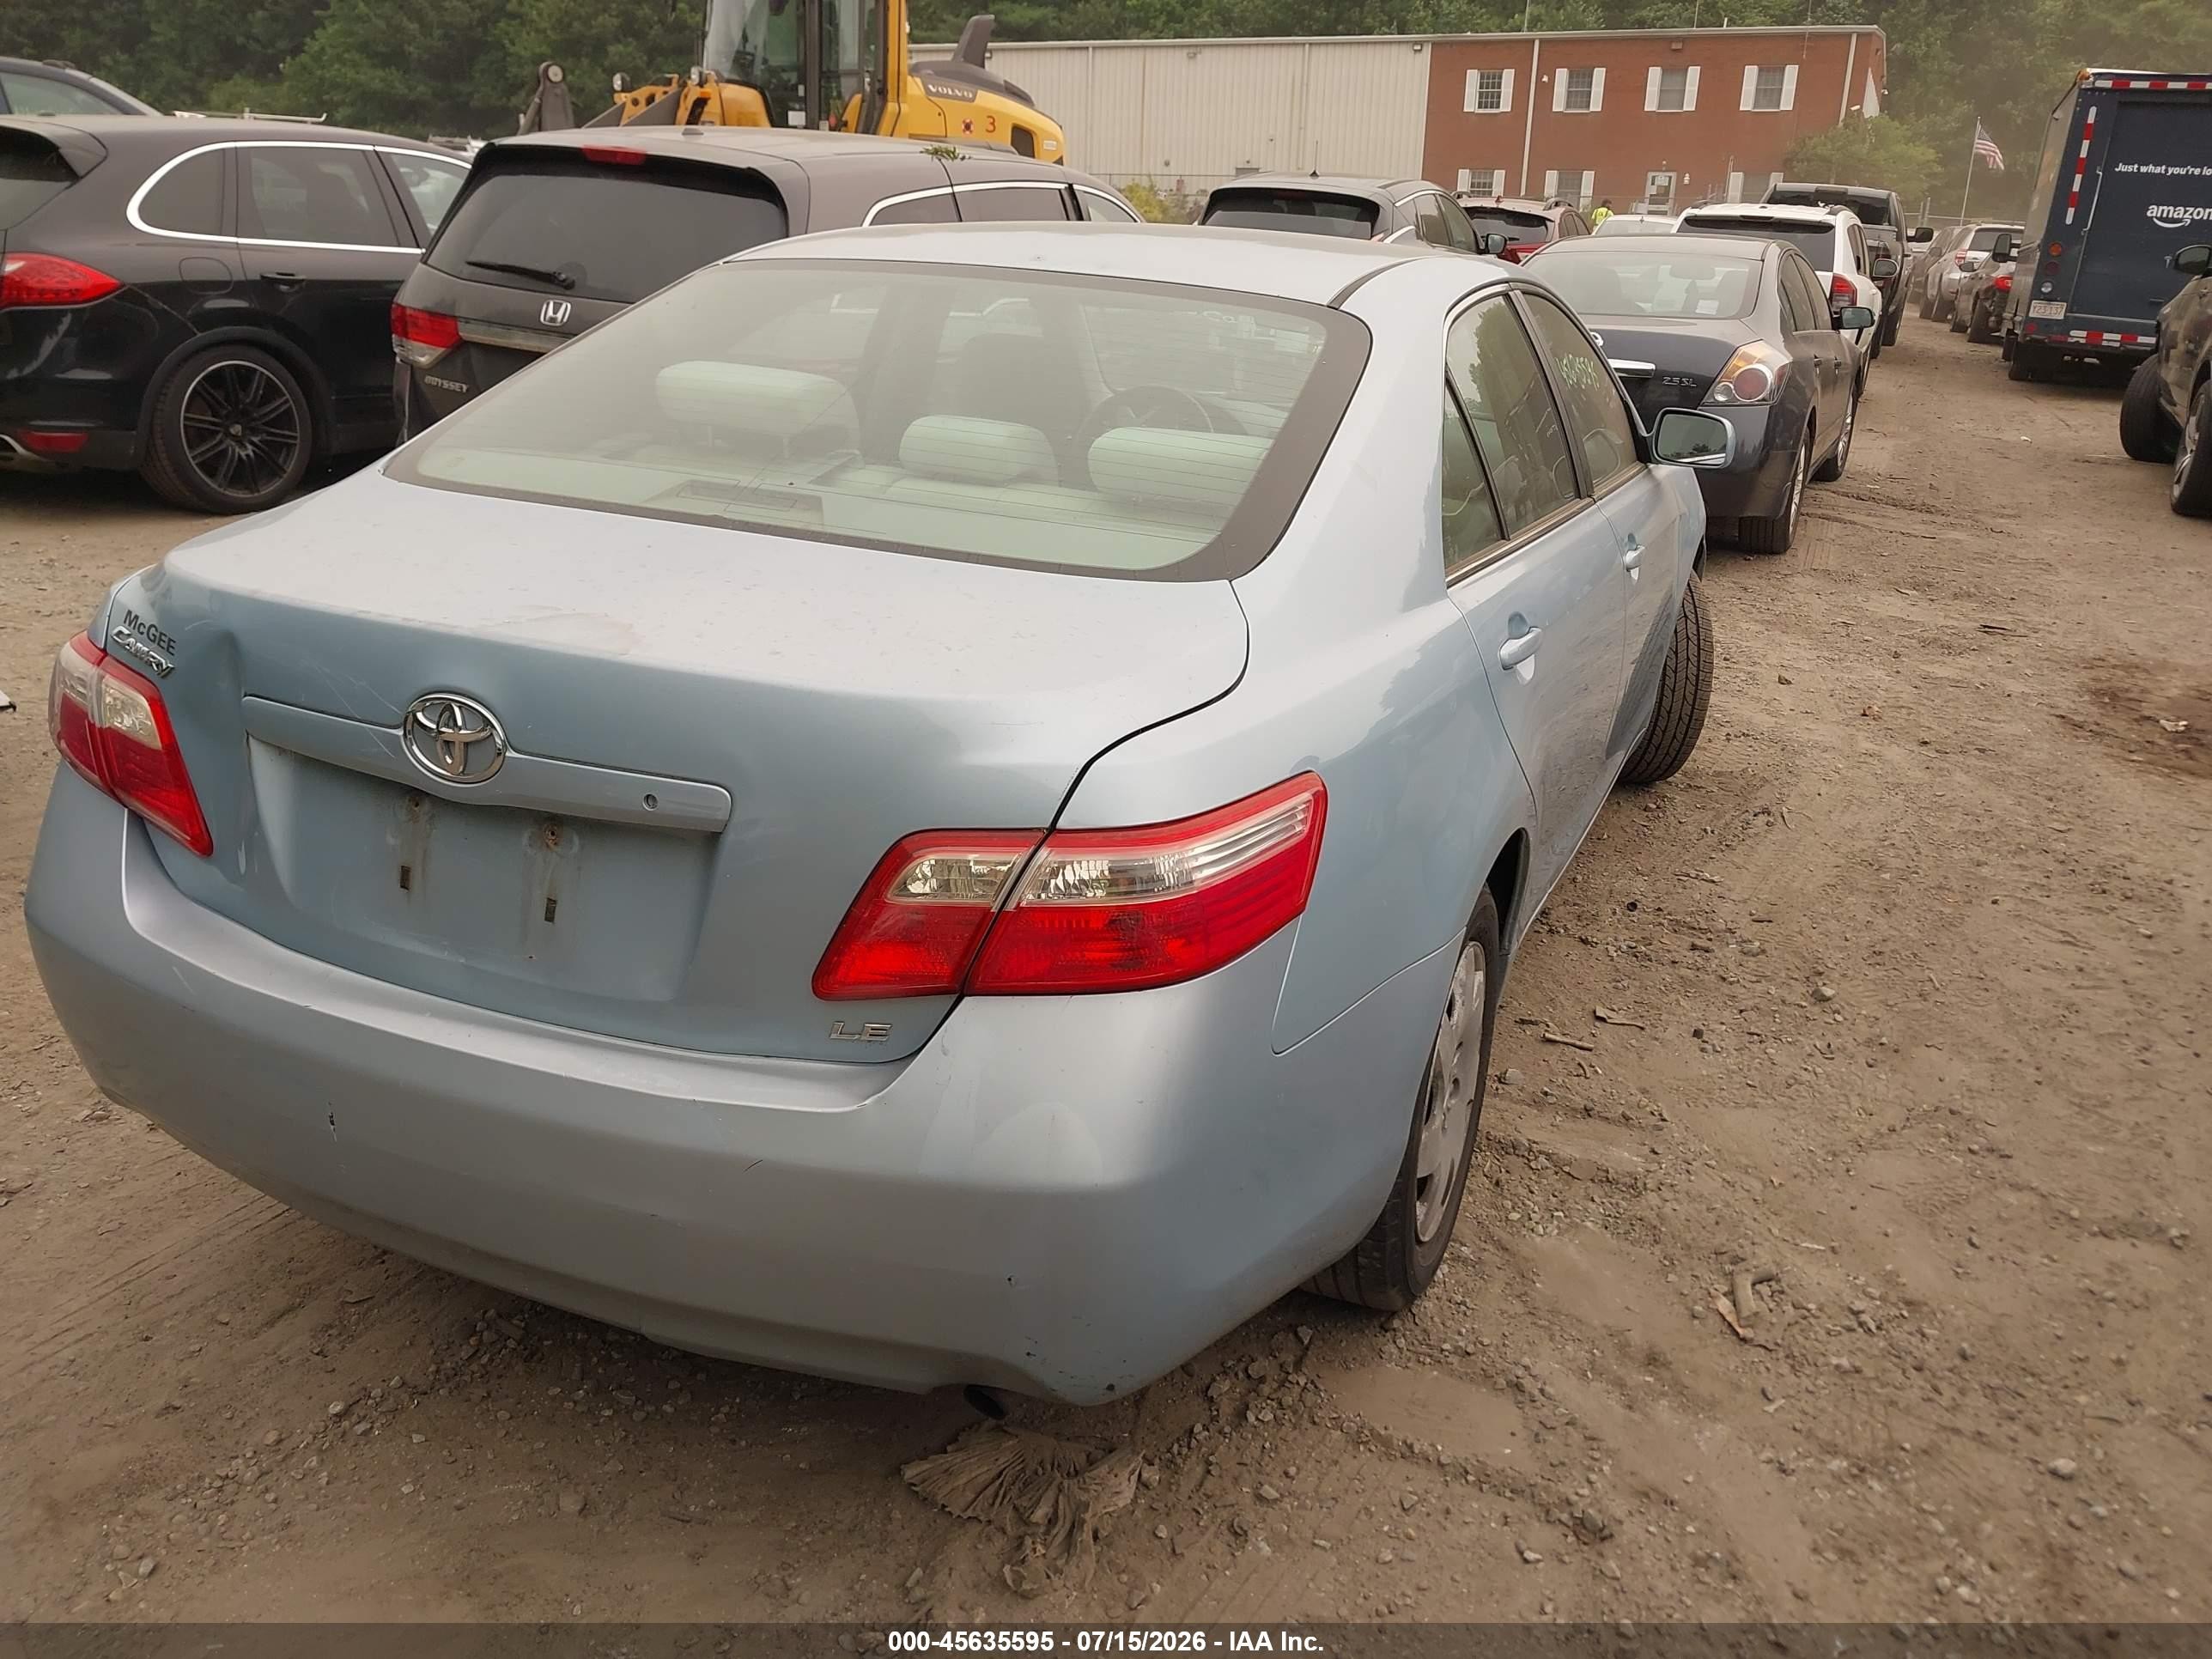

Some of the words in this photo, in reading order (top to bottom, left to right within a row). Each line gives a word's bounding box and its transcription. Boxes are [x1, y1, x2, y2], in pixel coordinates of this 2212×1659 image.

[927, 84, 973, 99] VOLVO
[986, 115, 996, 133] 3
[2115, 162, 2138, 173] Just
[2140, 164, 2166, 174] what
[2166, 165, 2200, 176] you're
[424, 374, 468, 393] ODYSSEY
[123, 609, 177, 657] McGEE
[829, 1022, 893, 1042] LE
